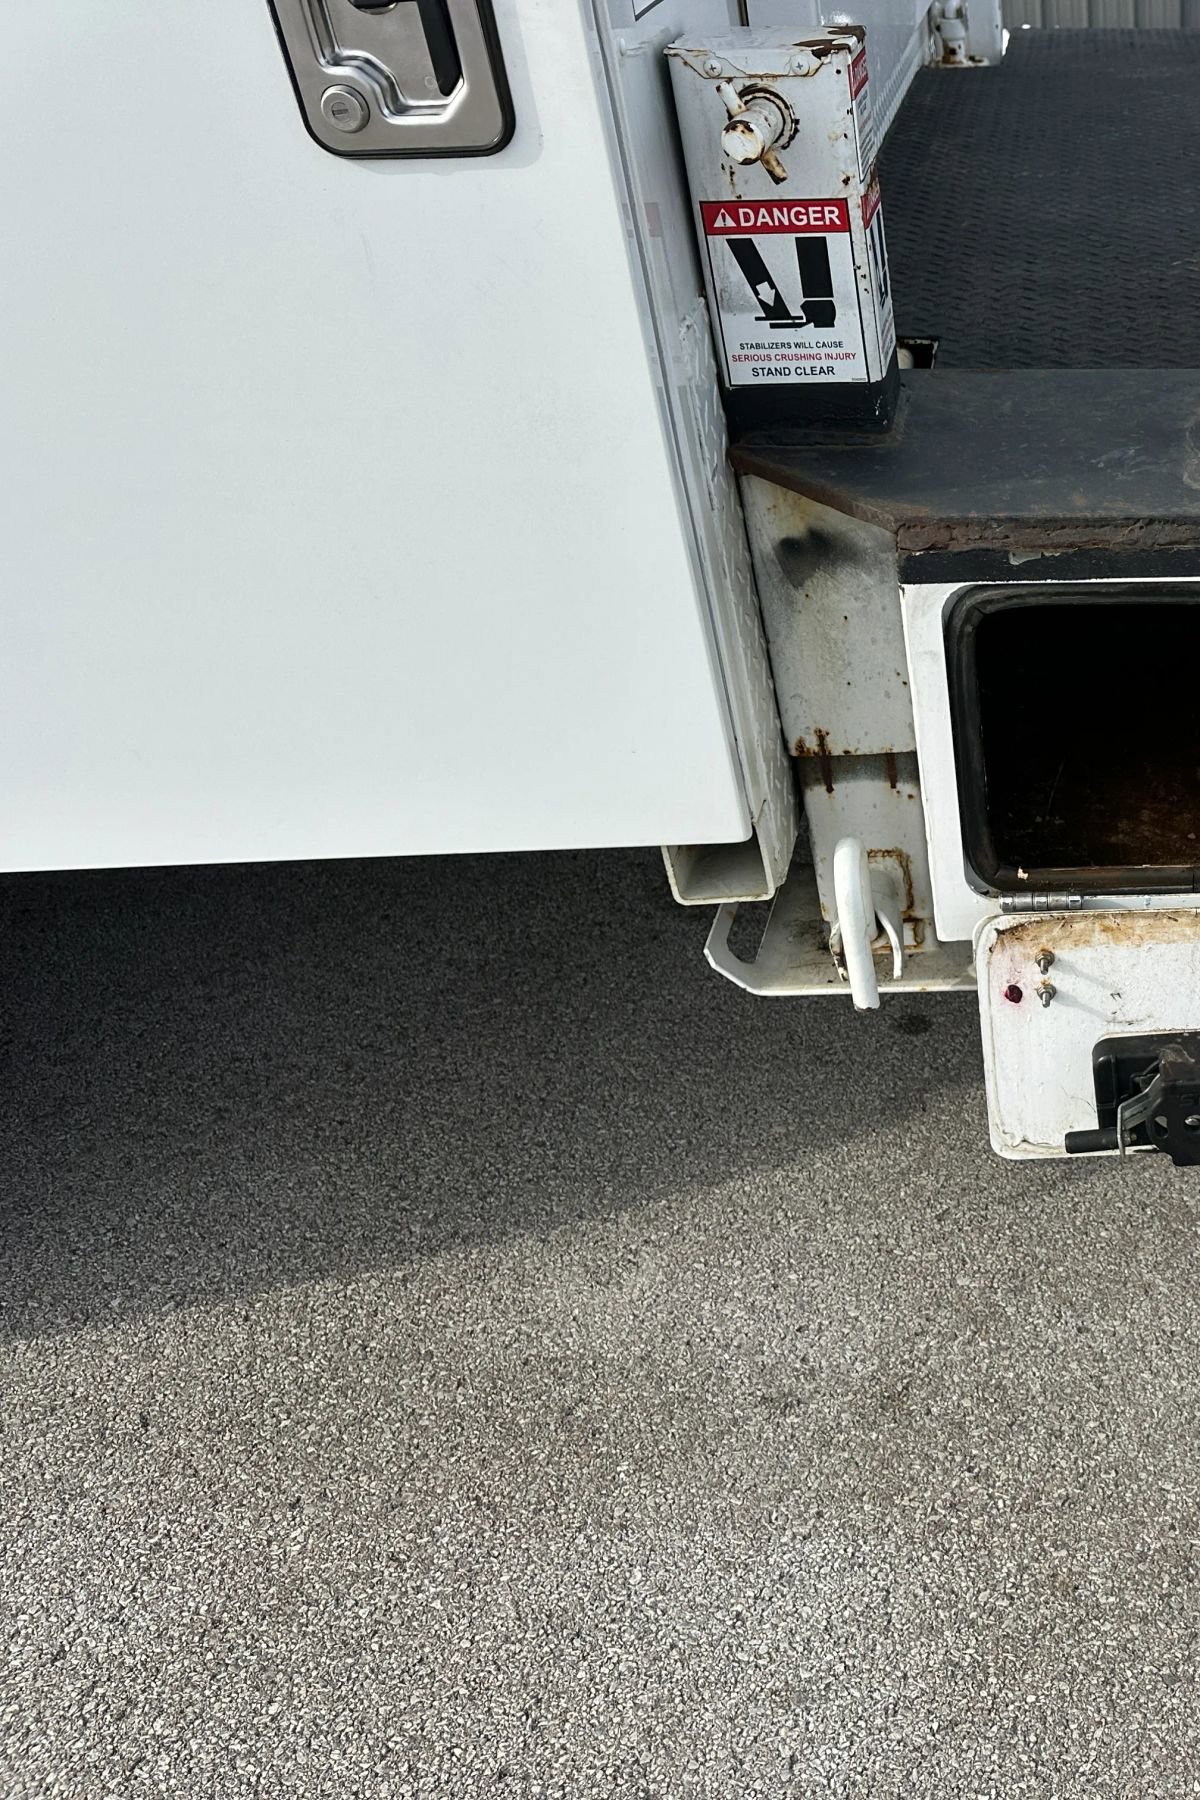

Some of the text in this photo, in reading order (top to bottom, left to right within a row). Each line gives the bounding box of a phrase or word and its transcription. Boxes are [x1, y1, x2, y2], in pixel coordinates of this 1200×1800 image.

[739, 206, 841, 227] DANGER
[740, 342, 792, 350] STABILIZERS
[816, 341, 844, 349] CAUSE
[732, 352, 857, 362] SERIOUS CRUSHING INJURY
[752, 366, 835, 377] STAND CLEAR
